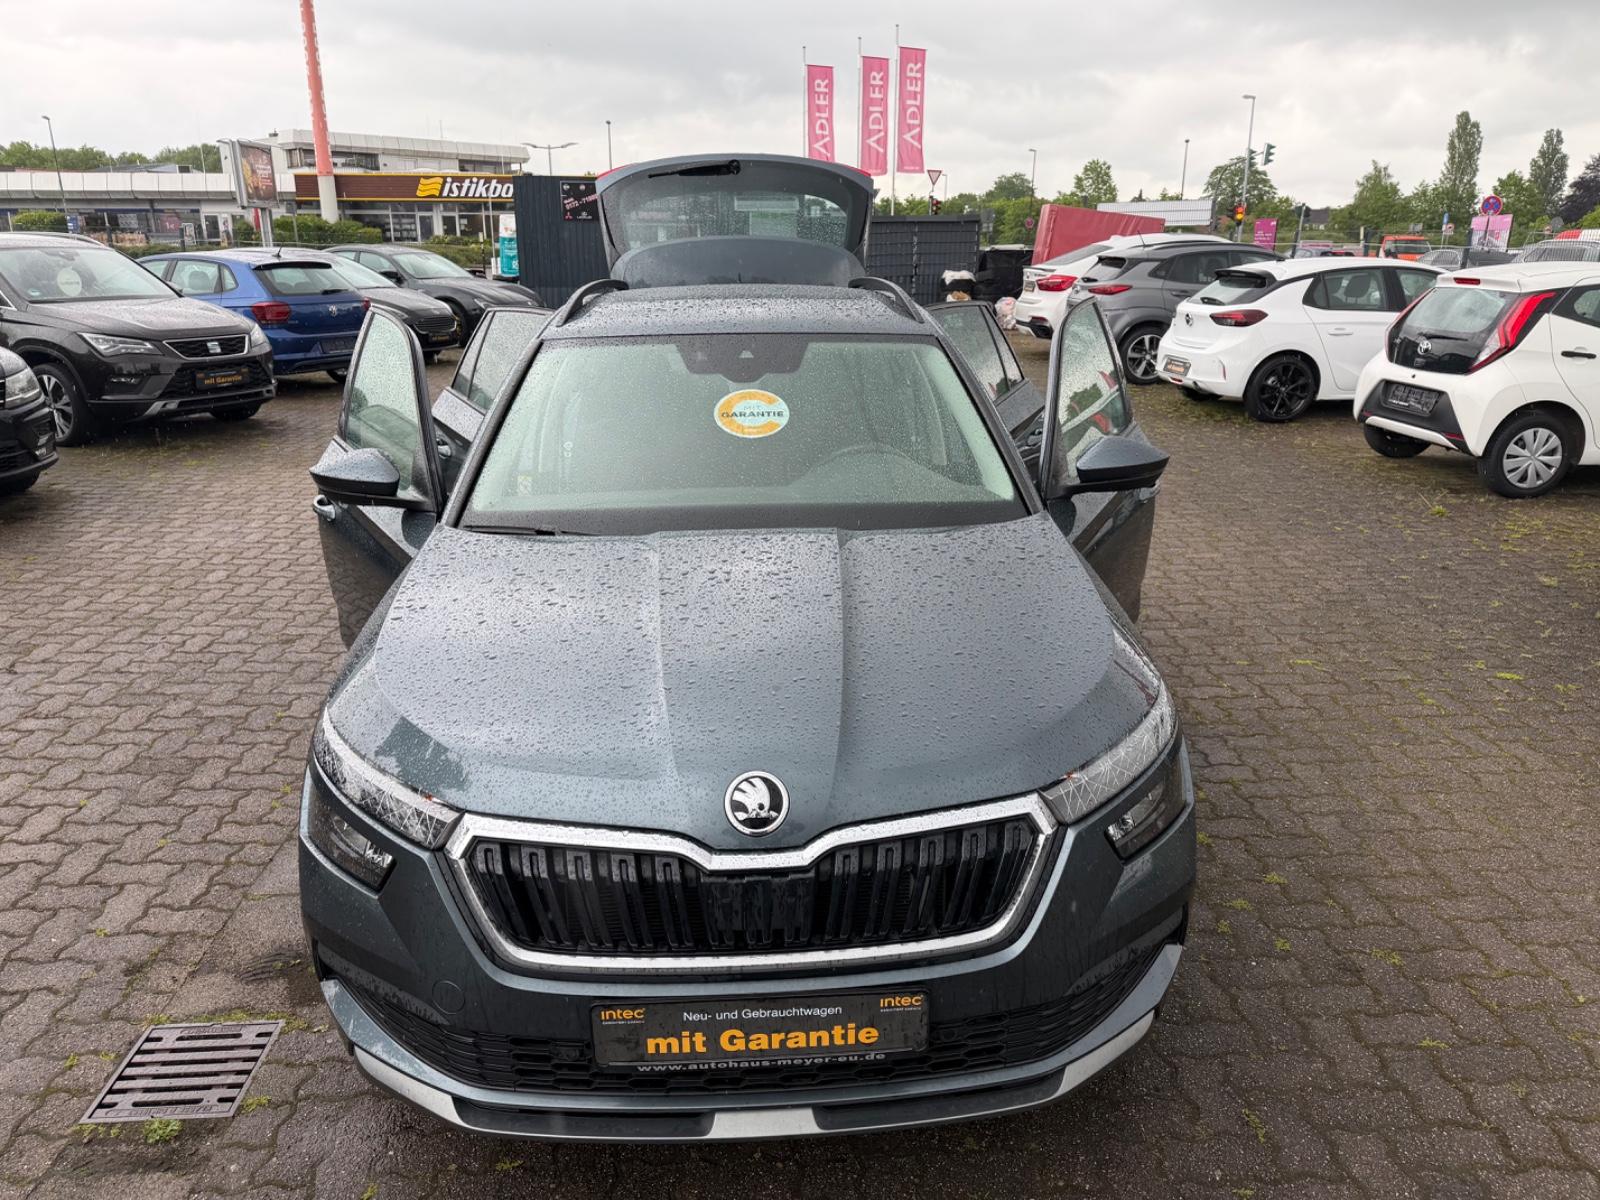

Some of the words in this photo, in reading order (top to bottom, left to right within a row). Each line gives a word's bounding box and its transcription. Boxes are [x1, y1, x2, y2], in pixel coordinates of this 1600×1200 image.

[865, 71, 885, 153] ADLER
[902, 62, 922, 149] ADLER
[813, 78, 831, 158] ADLER
[721, 410, 784, 418] GARANTIE
[880, 995, 924, 1008] intec
[601, 1008, 645, 1020] intec
[683, 1012, 712, 1022] Neu-
[715, 1010, 738, 1020] und
[741, 1006, 843, 1019] Gebrauchtwagen
[646, 1031, 707, 1054] mit
[719, 1023, 880, 1052] Garantie
[637, 1052, 887, 1072] www.autohaus-meyer-eu.de
